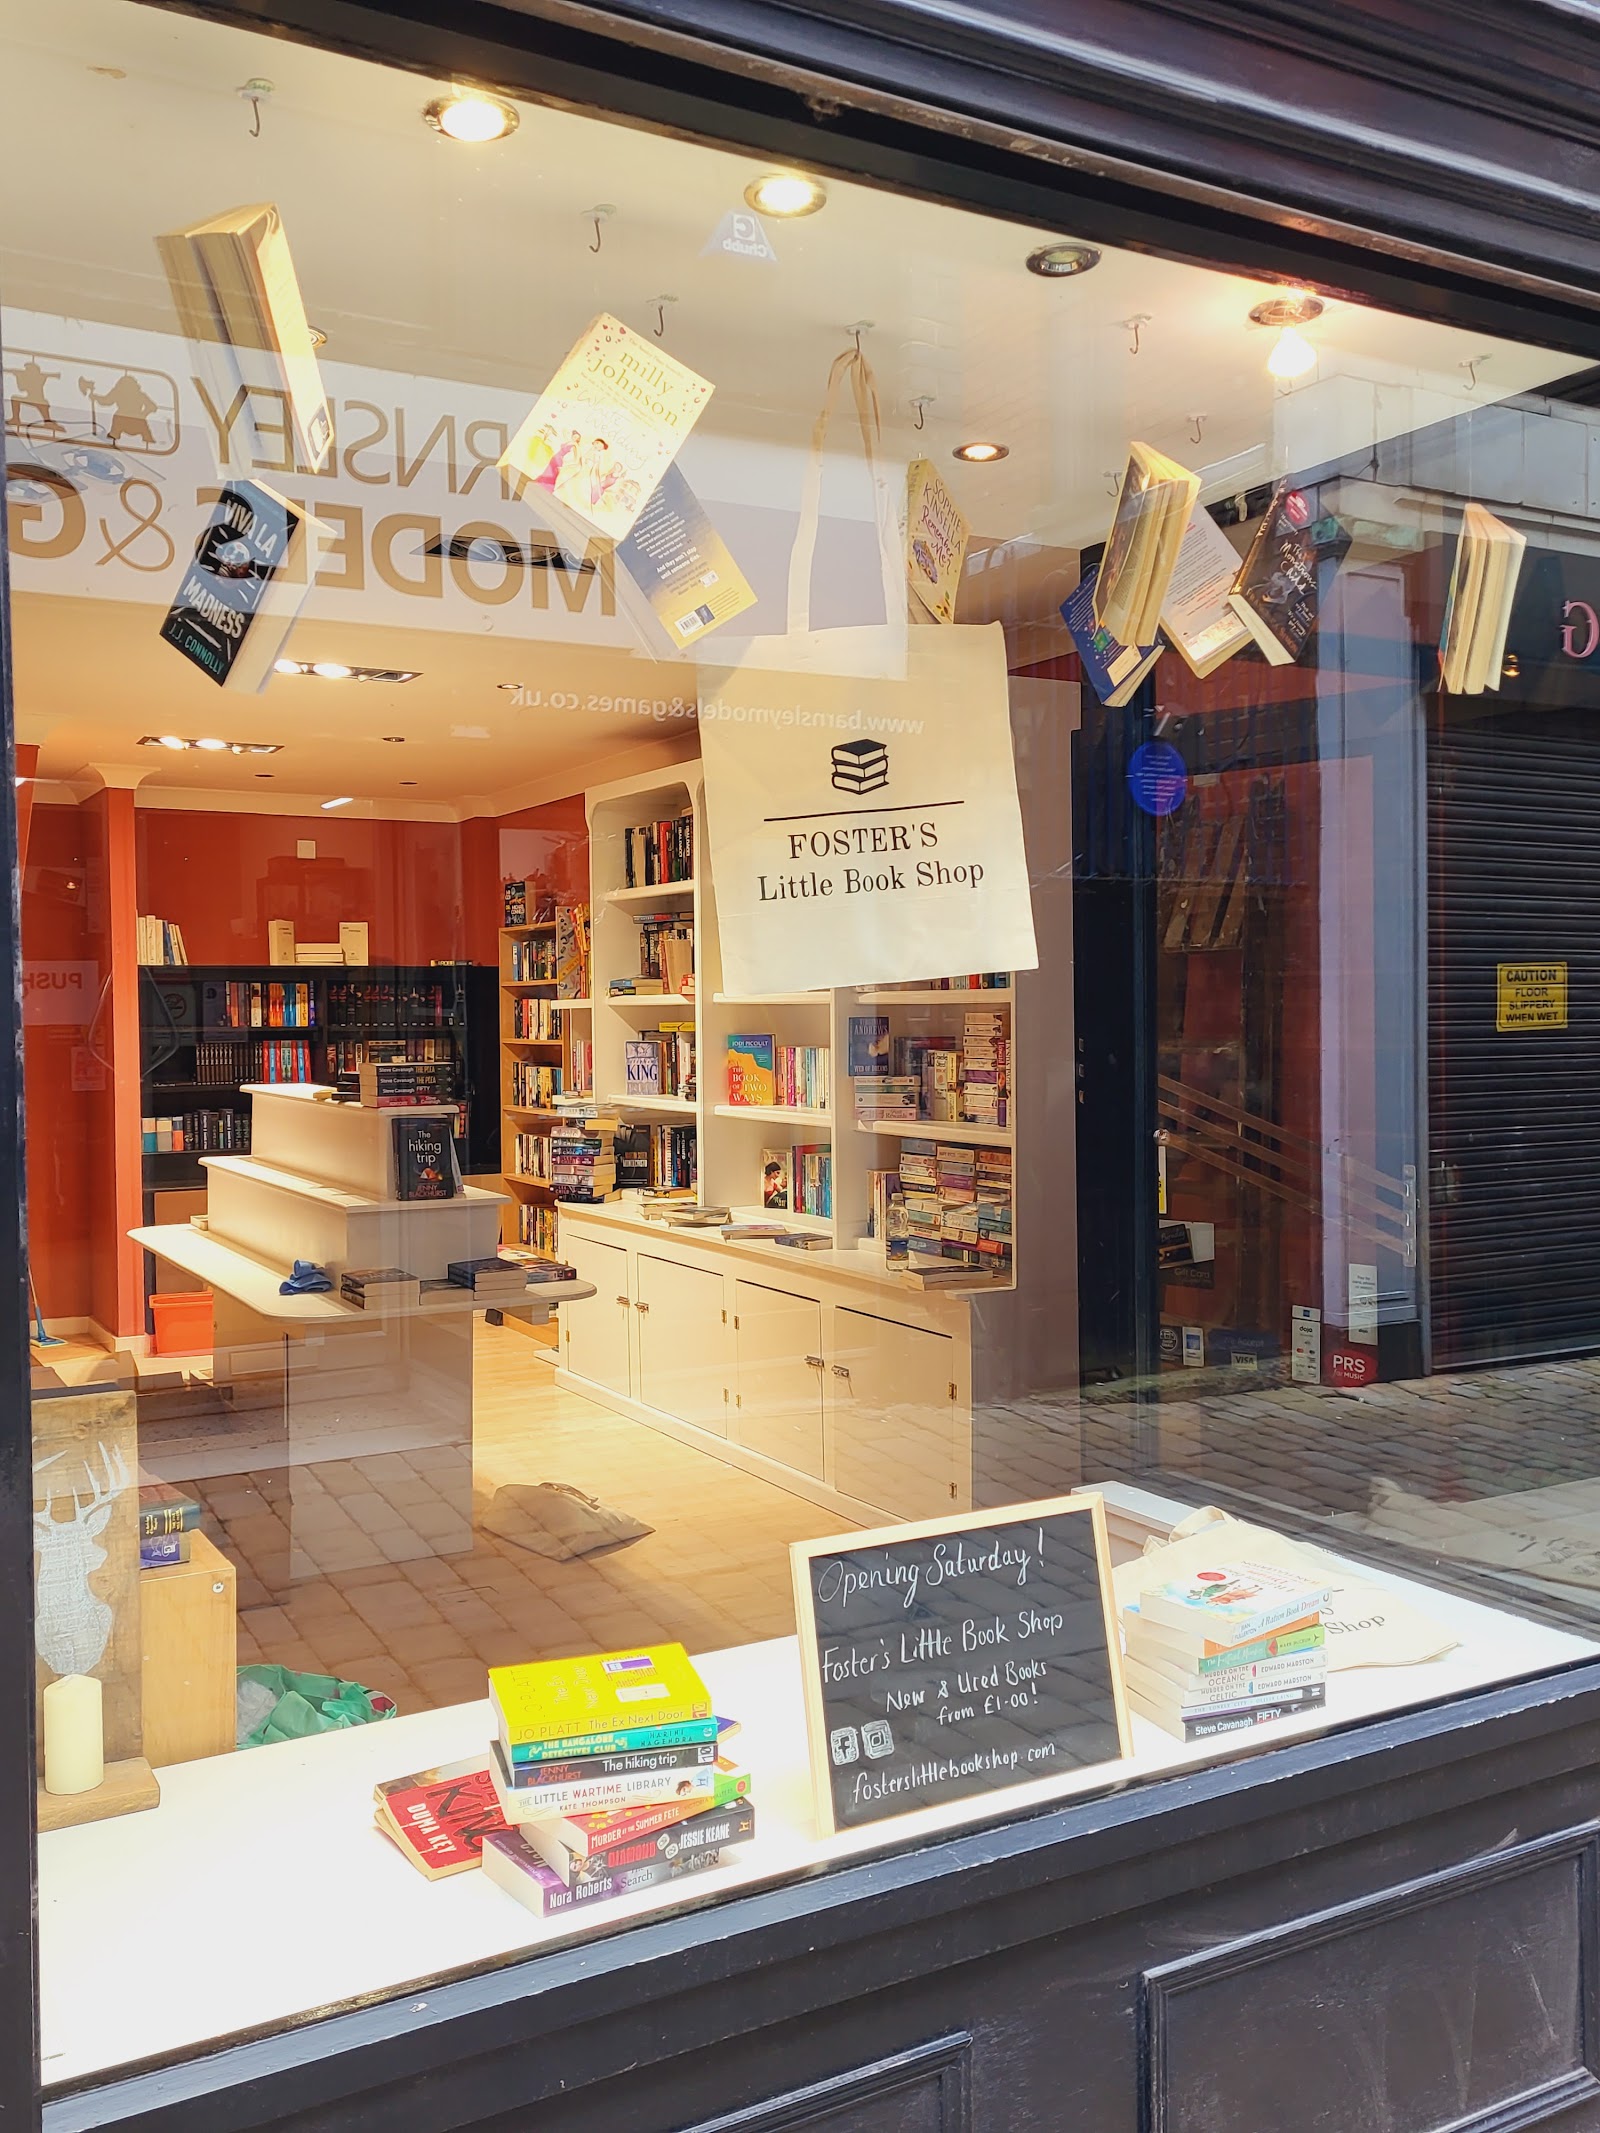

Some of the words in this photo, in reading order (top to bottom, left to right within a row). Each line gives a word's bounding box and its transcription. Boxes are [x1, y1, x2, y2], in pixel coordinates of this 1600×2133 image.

[620, 352, 674, 397] milly
[587, 358, 678, 427] johnson
[933, 478, 962, 533] SOPHIE
[923, 481, 962, 556] KINSELLA
[223, 498, 258, 540] VIVA
[254, 522, 279, 559] LA
[921, 504, 955, 559] Remember
[182, 574, 245, 640] MADNESS
[184, 634, 225, 675] CONNOLLY
[787, 821, 939, 860] FOSTER'S
[757, 871, 834, 901] Little
[843, 865, 906, 894] Book
[916, 860, 984, 889] Shop
[1506, 969, 1557, 983] CAUTION
[1515, 987, 1549, 998] FLOOR
[1508, 999, 1556, 1011] SLIPPERY
[1505, 1013, 1535, 1024] WHEN
[1536, 1011, 1559, 1021] WET
[854, 1024, 888, 1036] ANDREWS
[392, 1066, 415, 1074] Cavanagh
[627, 1064, 658, 1081] KING
[732, 1073, 761, 1083] BOOK
[393, 1077, 416, 1085] Cavanagh
[743, 1083, 767, 1092] TWO
[732, 1092, 764, 1102] WAYS
[417, 1130, 431, 1139] The
[408, 1139, 442, 1154] hiking
[416, 1152, 436, 1166] trip
[1235, 1356, 1254, 1365] VISA
[1333, 1354, 1366, 1373] PRS
[1343, 1371, 1364, 1381] MUSIC
[818, 1552, 921, 1608] Opening
[1265, 1611, 1285, 1626] Ration
[1286, 1606, 1300, 1618] Book
[1323, 1614, 1386, 1636] Shop
[822, 1638, 891, 1683] Foster's
[900, 1628, 952, 1664] Little
[962, 1616, 1011, 1652] Book
[1017, 1609, 1064, 1639] Shop
[1204, 1668, 1228, 1678] MURDER
[1208, 1673, 1246, 1687] OCEANIC
[1261, 1662, 1285, 1673] EDWARD
[1286, 1658, 1315, 1669] MARSTON
[885, 1689, 926, 1713] New
[1004, 1658, 1048, 1686] Books
[1200, 1684, 1225, 1695] MURDER
[1209, 1690, 1238, 1702] CELTIC
[1257, 1680, 1282, 1690] EDWARD
[1283, 1675, 1312, 1686] MARSTON
[936, 1705, 975, 1726] from
[1195, 1724, 1216, 1736] Steve
[1216, 1717, 1254, 1732] Cavanagh
[1256, 1708, 1282, 1721] FIFTY
[516, 1728, 535, 1741] JO
[540, 1722, 581, 1738] PLATT
[587, 1718, 610, 1730] The
[611, 1716, 625, 1728] Ex
[627, 1714, 654, 1725] Next
[658, 1710, 684, 1721] Door
[648, 1729, 684, 1739] HARINI
[542, 1739, 560, 1750] THE
[562, 1734, 614, 1748] BANGALORE
[640, 1736, 693, 1747] NAGENDRA
[540, 1764, 570, 1776] JENNY
[602, 1758, 623, 1772] The
[625, 1754, 658, 1771] hiking
[658, 1753, 678, 1768] trip
[527, 1771, 582, 1786] BLACKHURST
[853, 1742, 1057, 1804] fosterslittlebookshop.com
[533, 1791, 569, 1806] LITTLE
[572, 1783, 623, 1798] WARTIME
[626, 1776, 672, 1793] LIBRARY
[559, 1802, 578, 1812] KATE
[581, 1796, 626, 1809] THOMPSON
[406, 1802, 442, 1836] DUMA
[427, 1832, 458, 1854] KEY
[590, 1829, 622, 1850] MURDER
[635, 1813, 663, 1831] SUMMER
[662, 1806, 680, 1822] FETE
[678, 1827, 705, 1850] JESSIE
[705, 1822, 731, 1844] KEANE
[620, 1870, 653, 1889] Search
[549, 1890, 573, 1909] Nora
[575, 1876, 613, 1900] Roberts
